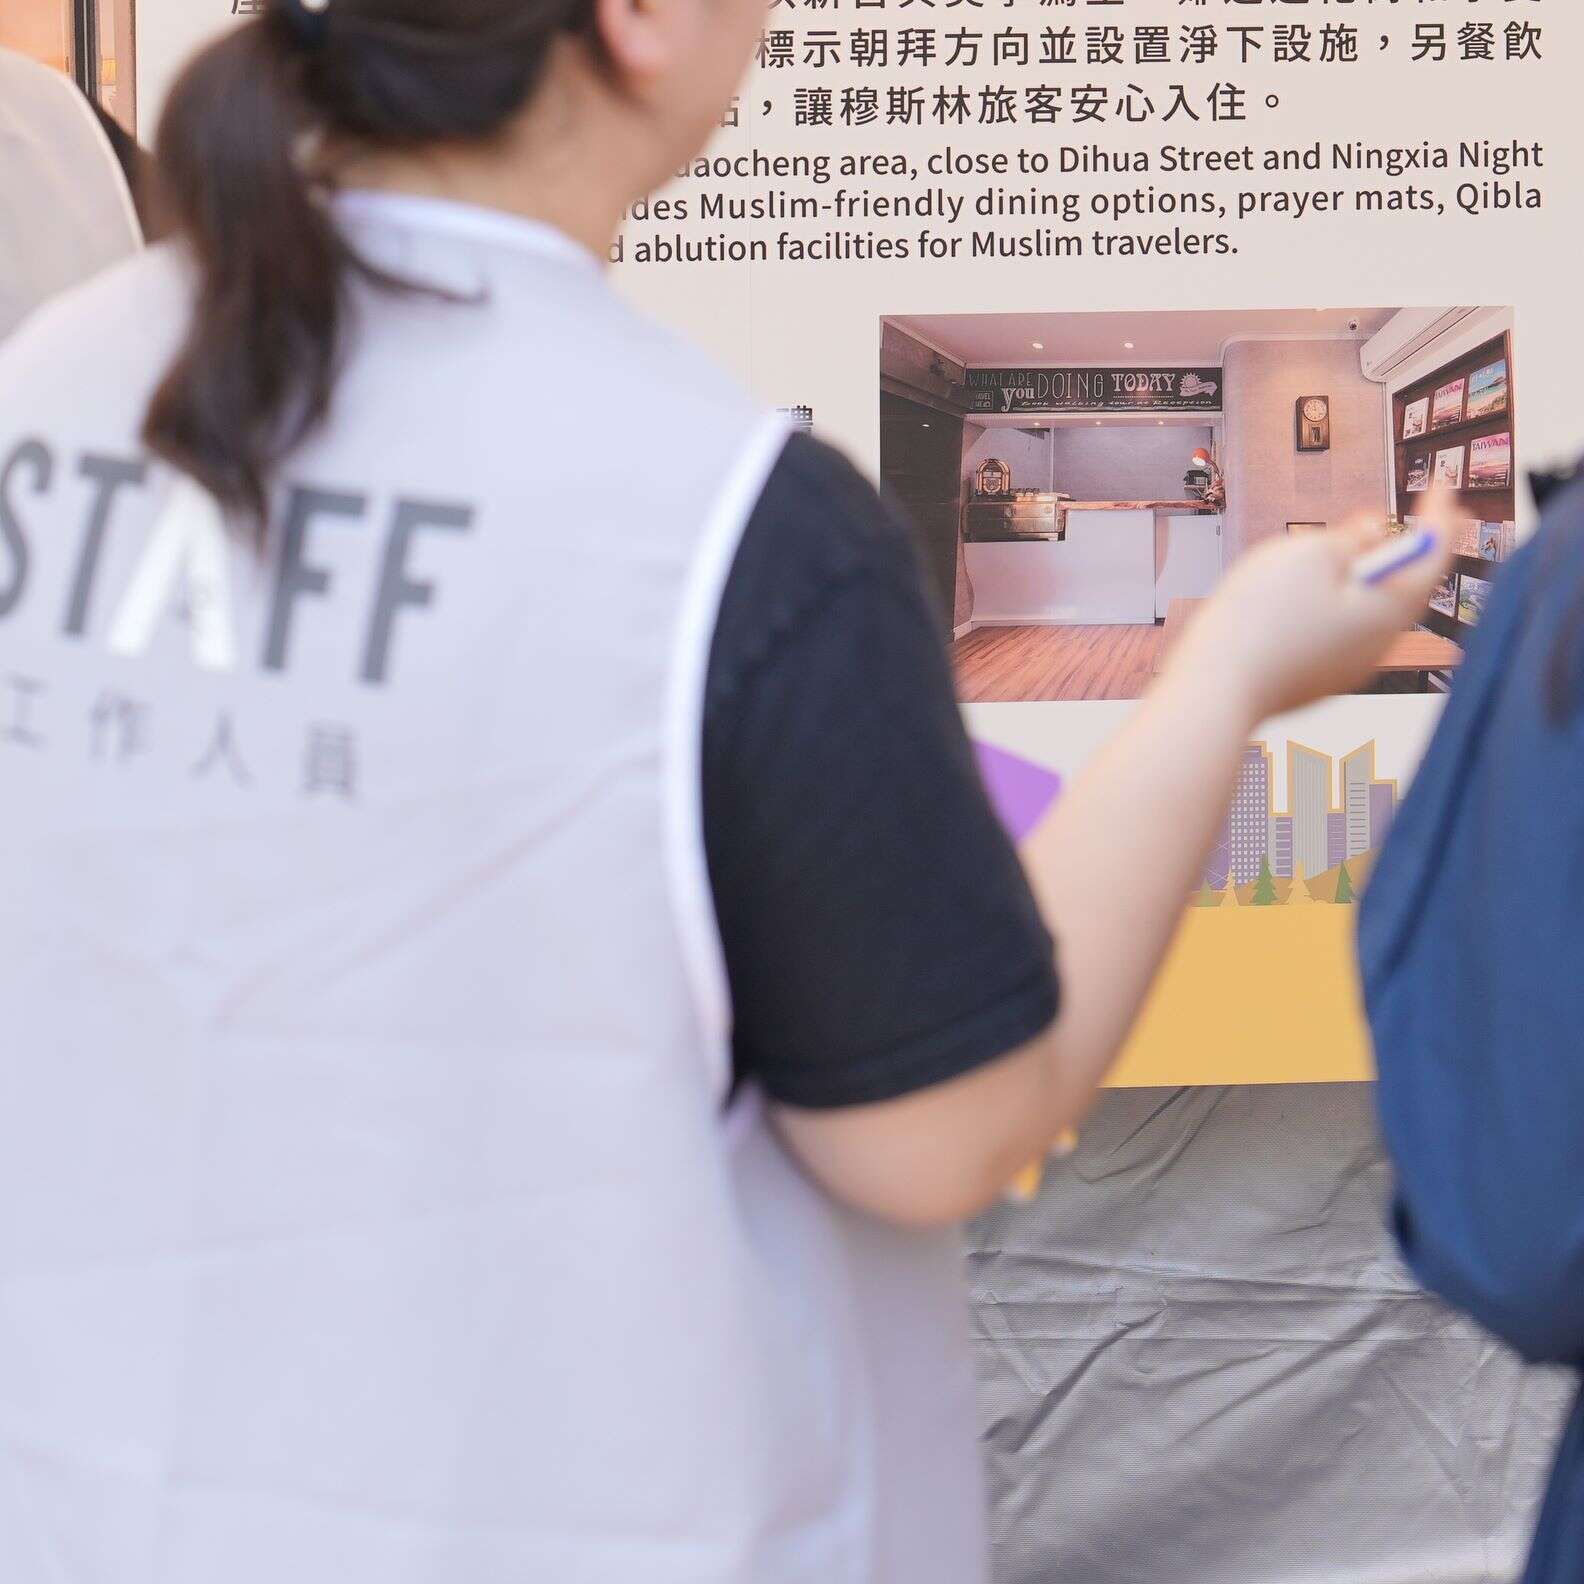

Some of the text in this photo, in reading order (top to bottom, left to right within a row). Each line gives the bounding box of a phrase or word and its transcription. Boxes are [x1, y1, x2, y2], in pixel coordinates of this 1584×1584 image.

[840, 155, 917, 181] area,
[928, 147, 1008, 174] close
[1017, 149, 1048, 173] to
[1060, 145, 1148, 172] Dihua
[1160, 145, 1254, 171] Street
[1264, 142, 1320, 170] and
[1333, 141, 1448, 176] Ningxia
[1460, 140, 1543, 175] Night
[701, 188, 964, 223] Muslim-friendly
[976, 187, 1080, 222] dining
[1091, 186, 1225, 221] options,
[1239, 191, 1344, 219] prayer
[1356, 185, 1444, 215] mats,
[1457, 181, 1541, 215] Qibla
[635, 234, 766, 262] ablution
[777, 232, 909, 260] facilities
[918, 230, 962, 258] for
[973, 229, 1082, 257] Muslim
[1092, 227, 1238, 256] travelers.
[1037, 373, 1104, 399] DOING
[1111, 373, 1176, 393] TODAY
